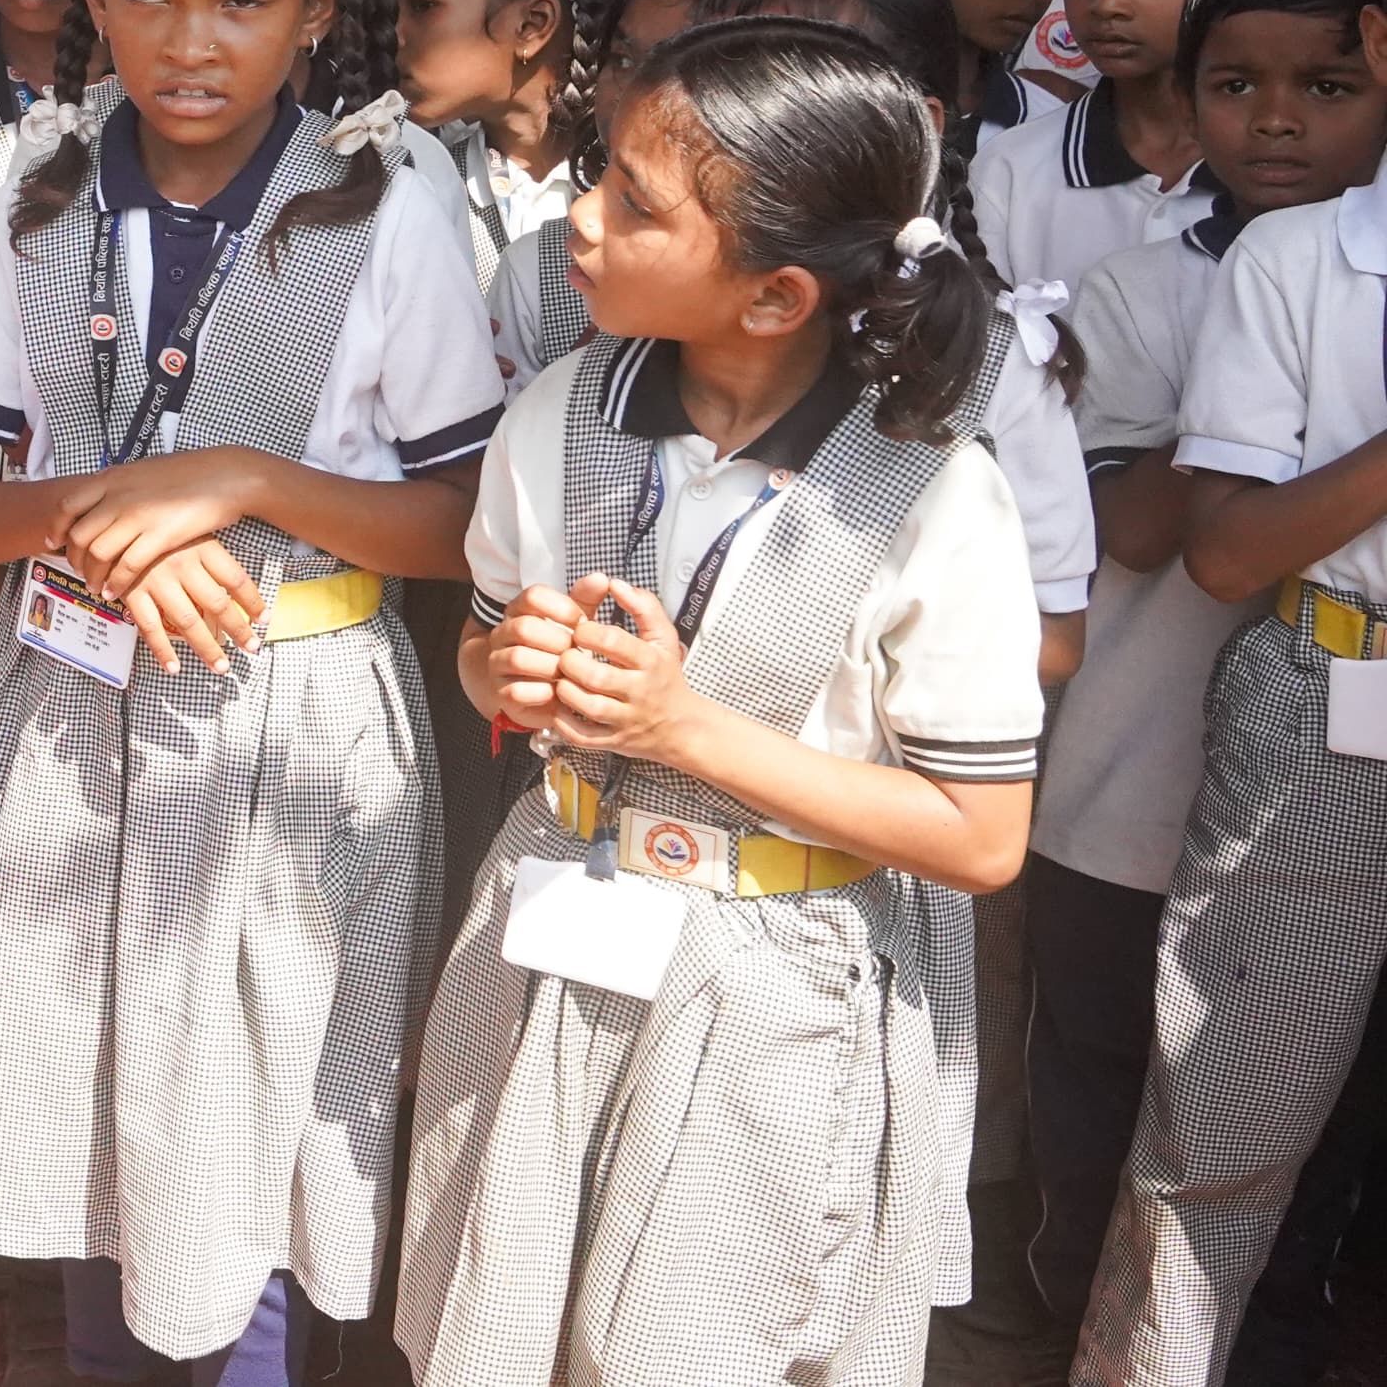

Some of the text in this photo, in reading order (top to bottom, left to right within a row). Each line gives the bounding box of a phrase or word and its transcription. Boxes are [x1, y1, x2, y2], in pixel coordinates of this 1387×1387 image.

[179, 306, 204, 341] नियति
[197, 270, 221, 307] पब्लिक
[152, 383, 169, 413] टाटरी
[680, 594, 705, 630] नियति
[697, 553, 721, 594] पब्लिक
